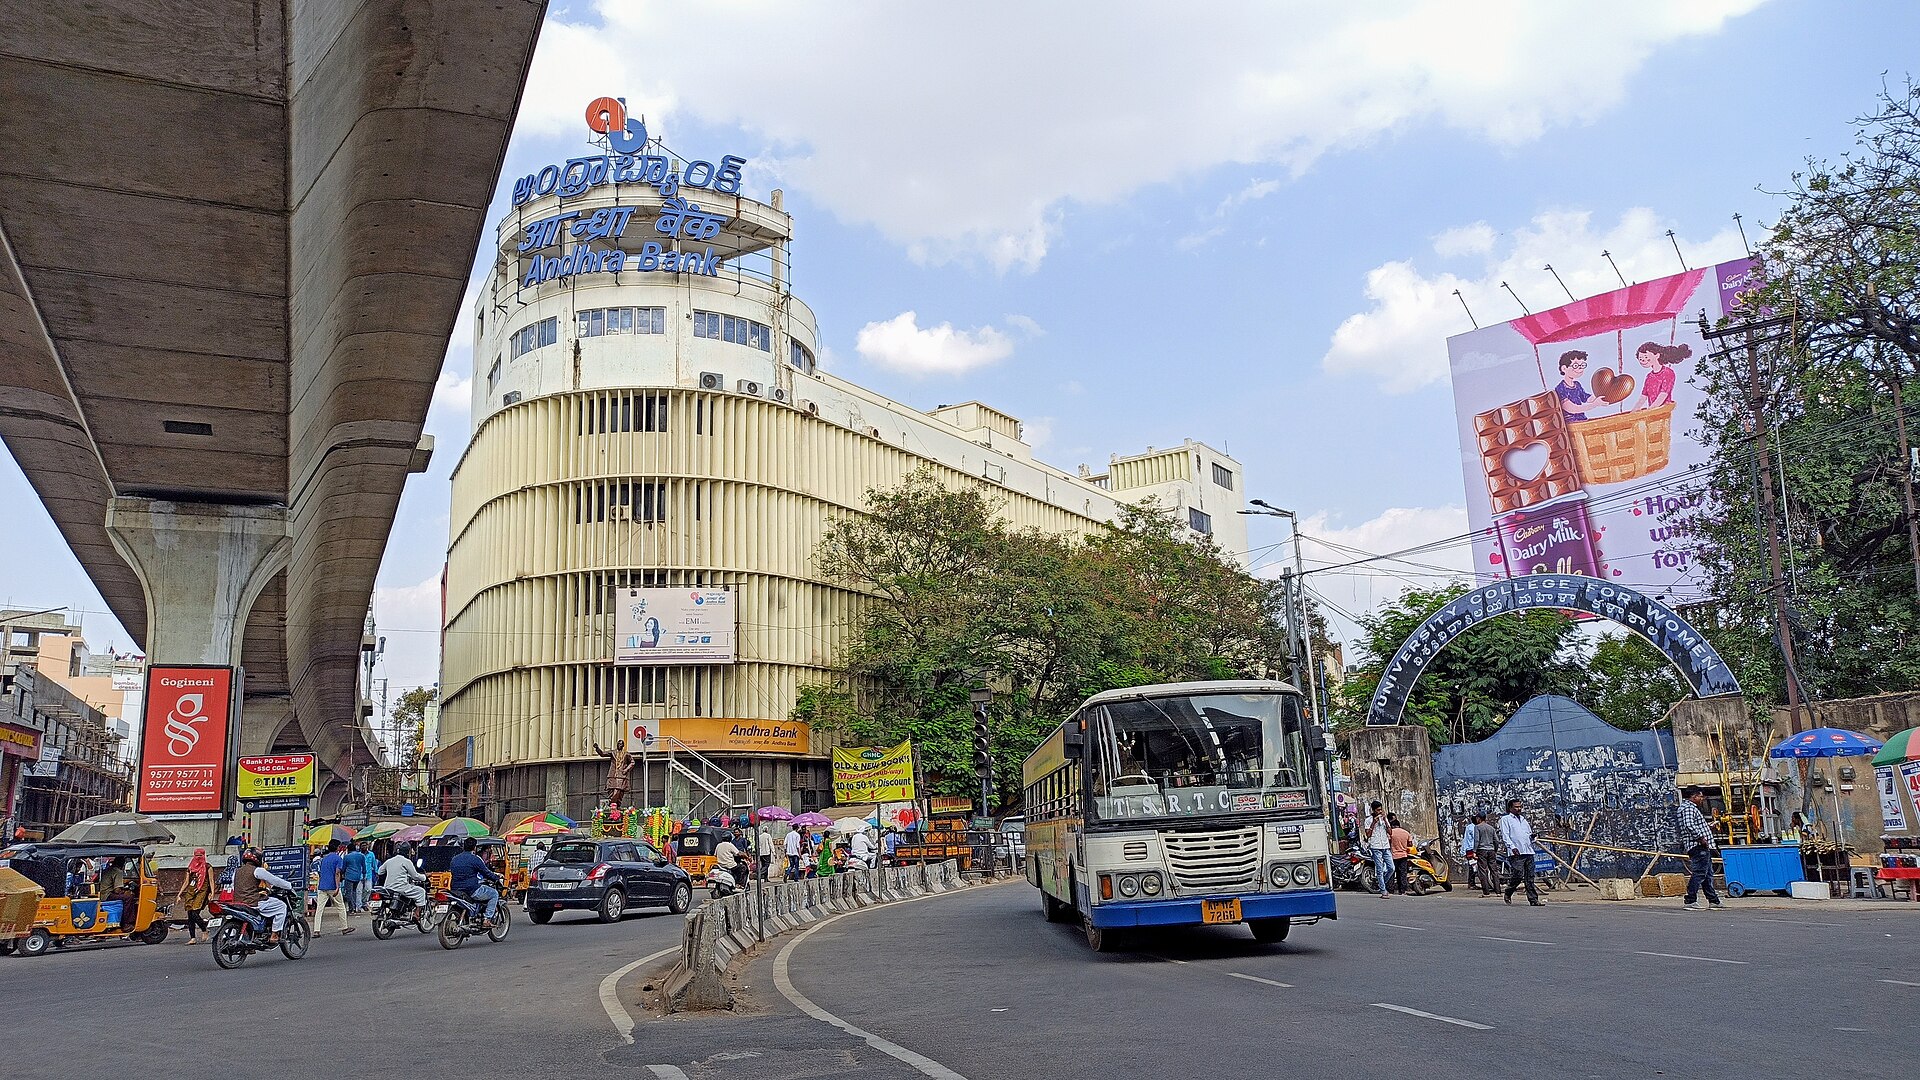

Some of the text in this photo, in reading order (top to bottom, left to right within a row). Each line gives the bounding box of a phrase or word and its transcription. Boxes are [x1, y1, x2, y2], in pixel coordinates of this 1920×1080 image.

[523, 241, 721, 288] Andhra Bank
[1722, 278, 1743, 290] Dairy
[1513, 524, 1545, 543] Cadbury
[1510, 525, 1584, 562] Dairy Milk
[1652, 550, 1691, 569] for
[1376, 578, 1717, 707] UNIVERSITY COLLEGE FOR WOMEN
[160, 676, 215, 688] Gogineni
[729, 724, 798, 739] Andhra Bank
[861, 762, 879, 771] NEW
[150, 769, 213, 779] 9577 9577 11
[149, 779, 214, 789] 9577 9577 44
[836, 777, 911, 790] 10 to 50 % Discount
